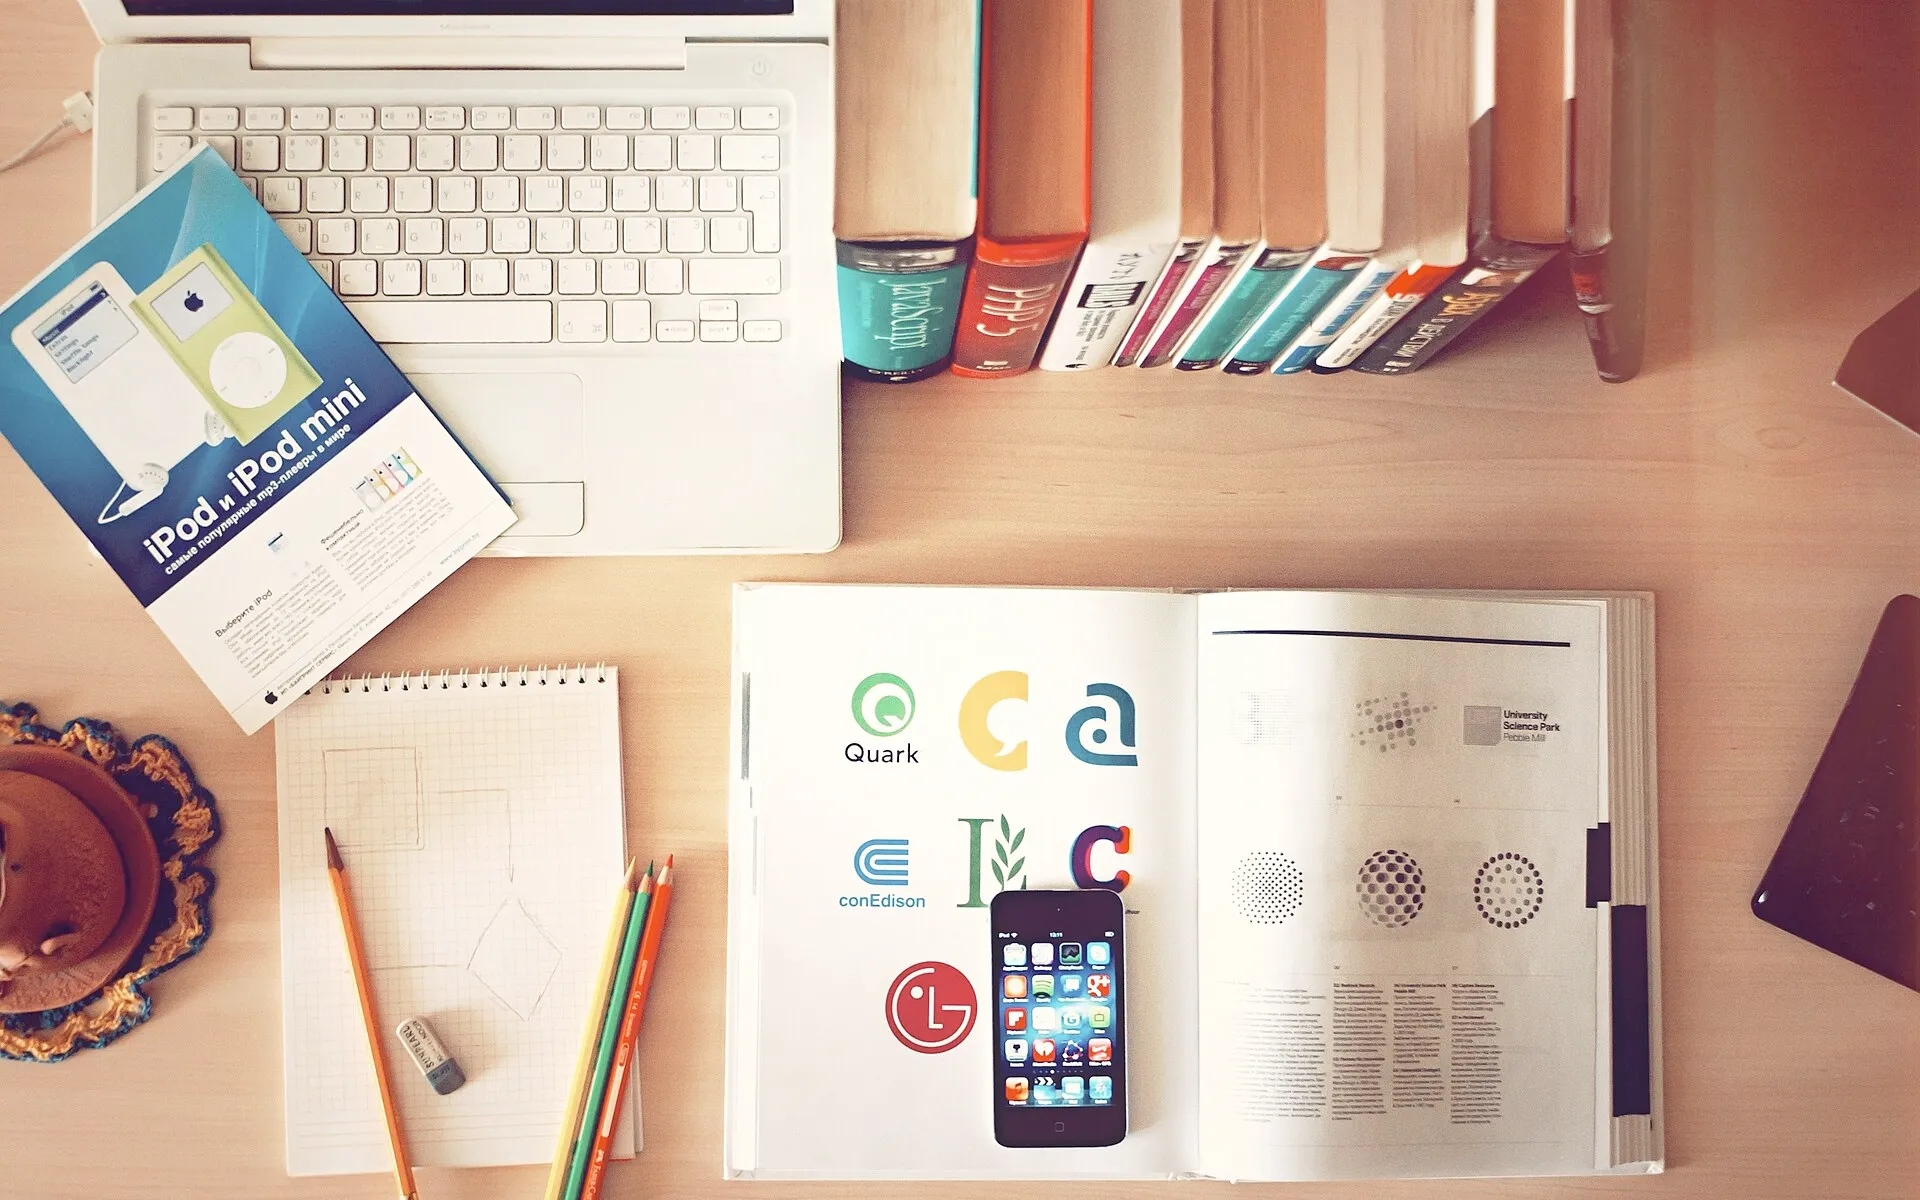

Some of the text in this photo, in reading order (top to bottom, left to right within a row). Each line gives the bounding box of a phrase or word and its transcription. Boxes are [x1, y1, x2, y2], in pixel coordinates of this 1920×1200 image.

[875, 275, 947, 352] JavaScript
[980, 283, 1055, 321] PHP
[977, 320, 1039, 337] 5
[143, 377, 367, 566] iPod и iPod mini
[164, 543, 199, 577] самые
[195, 493, 258, 553] популярные
[256, 447, 319, 508] mp3-плееры
[325, 422, 353, 451] мире
[214, 588, 275, 639] Выберите iPod
[1503, 710, 1548, 721] University
[1503, 722, 1560, 731] Science Park
[1532, 734, 1546, 742] Mill
[845, 743, 919, 764] Quark
[839, 894, 925, 908] conEdison
[403, 1026, 434, 1068] SUNPEARL
